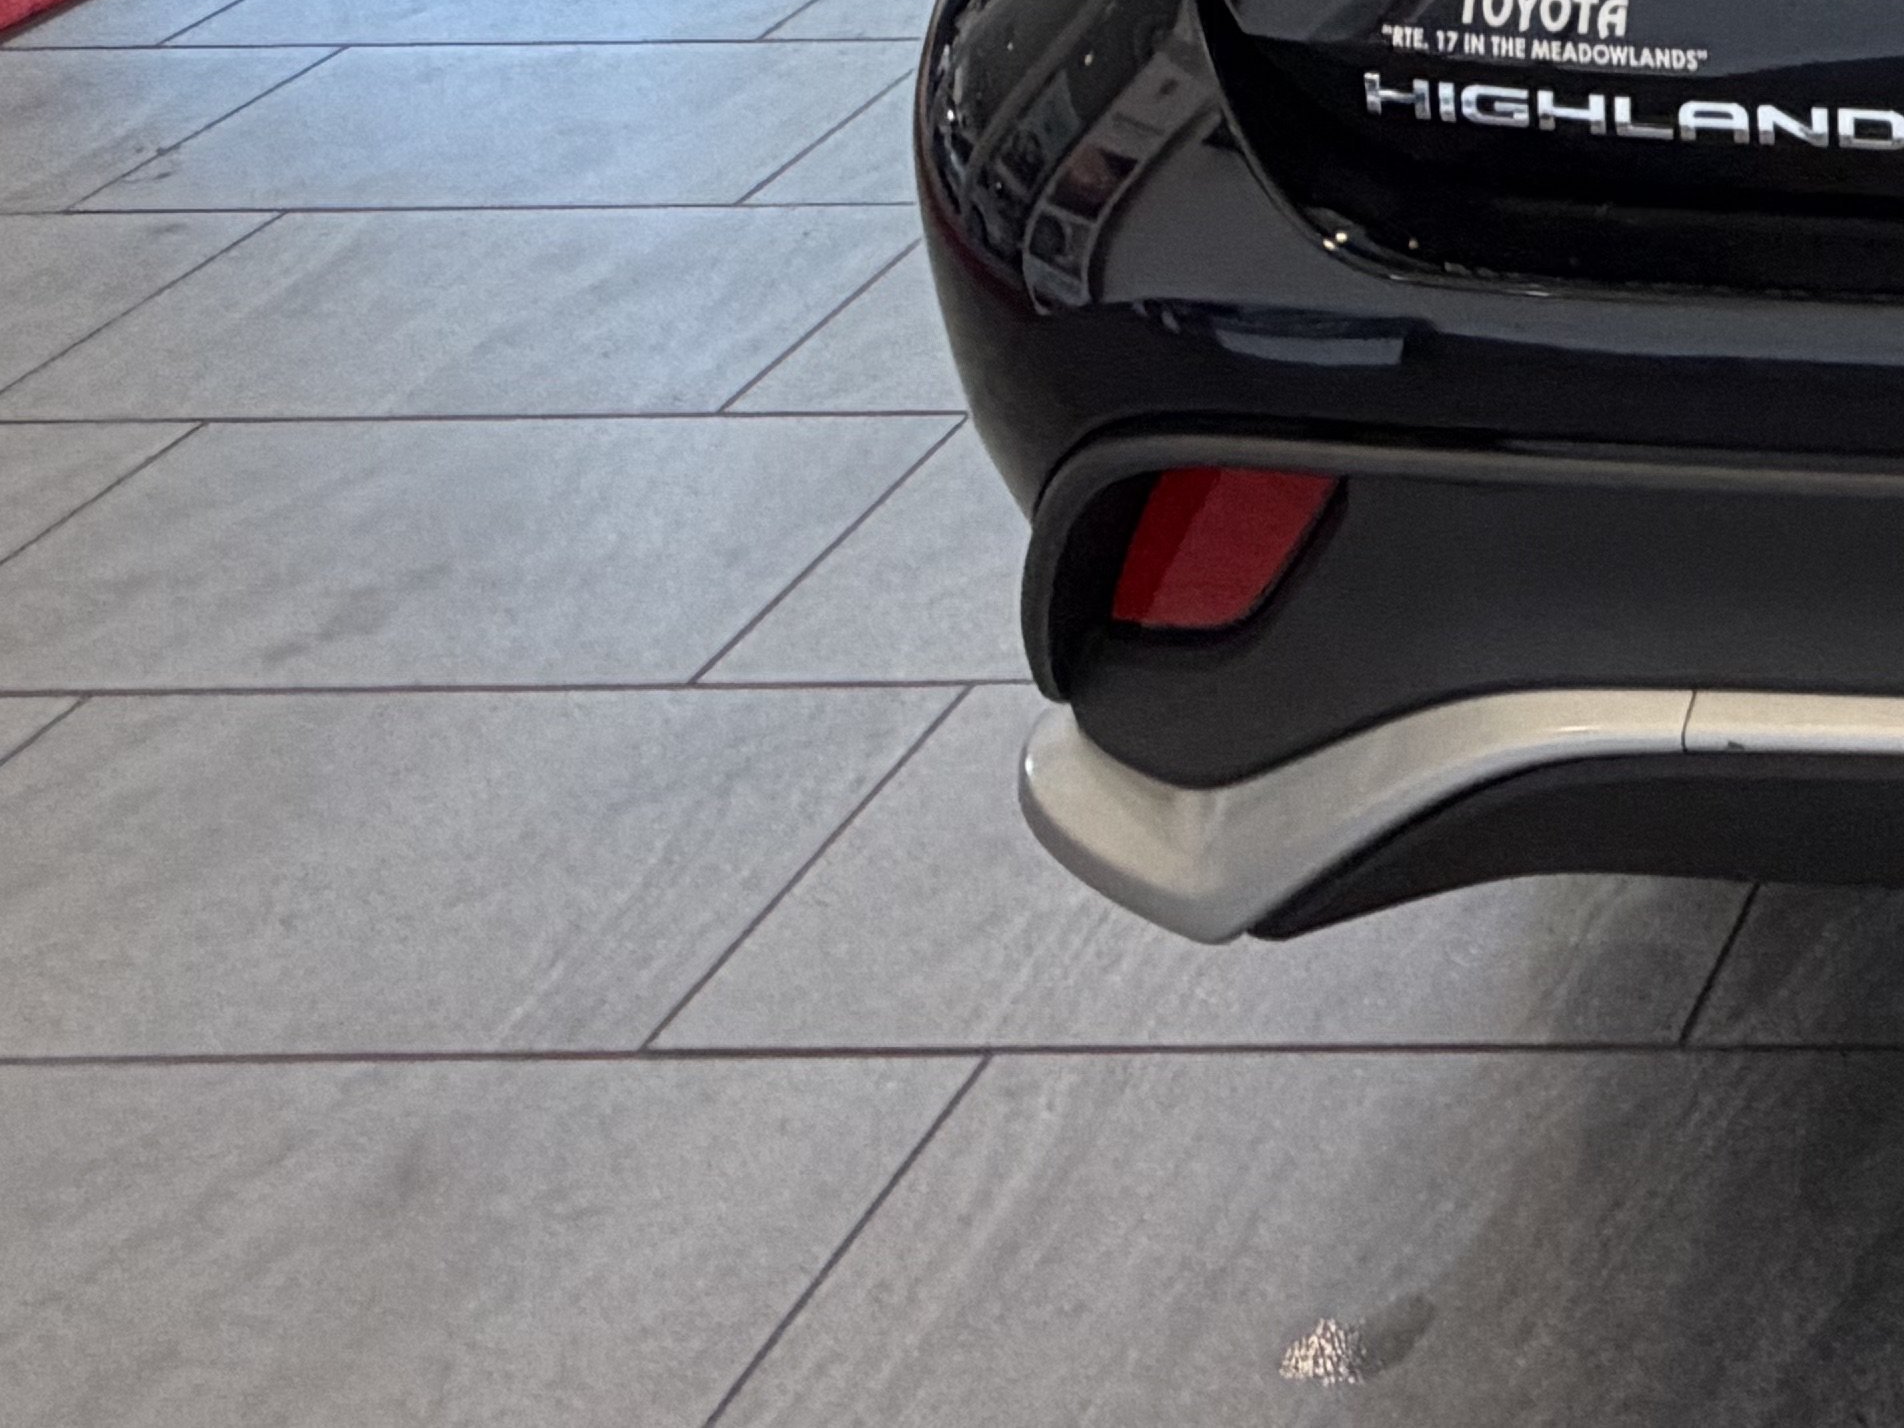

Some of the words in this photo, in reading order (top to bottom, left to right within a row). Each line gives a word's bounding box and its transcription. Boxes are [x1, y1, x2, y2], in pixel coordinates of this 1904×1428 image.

[1436, 30, 1459, 52] 17
[1464, 33, 1485, 56] IN
[1491, 35, 1526, 59] THE
